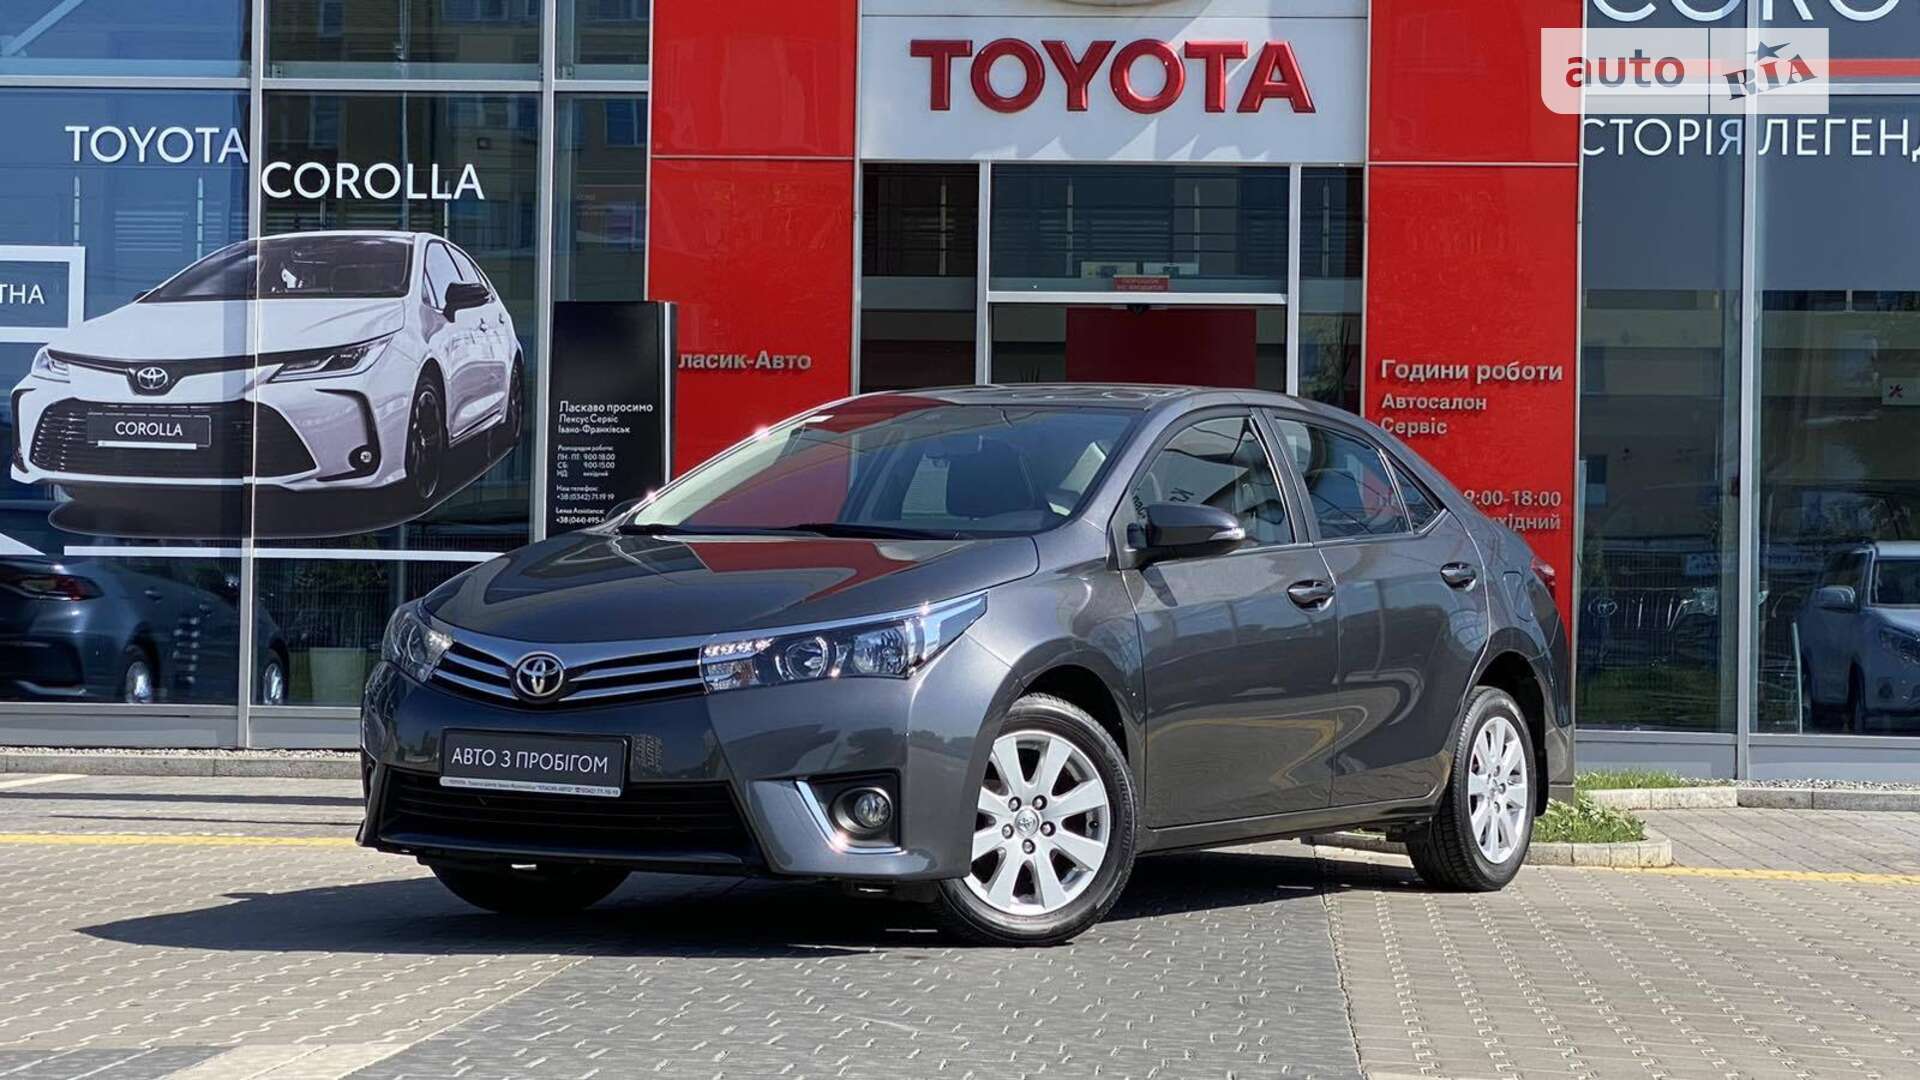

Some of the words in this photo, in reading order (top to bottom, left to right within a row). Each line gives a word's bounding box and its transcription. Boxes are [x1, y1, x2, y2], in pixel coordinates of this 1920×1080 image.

[910, 37, 1317, 114] TOYOTA
[65, 125, 249, 163] TOYOTA
[1583, 118, 1742, 156] СТОРІЯ
[1758, 118, 1920, 163] ЛЕГЕН
[261, 161, 485, 200] COROLLA
[1381, 359, 1469, 381] Години
[1477, 361, 1563, 385] роботи
[606, 403, 654, 414] просимо
[1381, 393, 1487, 410] Автосалон
[115, 421, 183, 437] COROLLA
[1380, 417, 1448, 437] Сервіс
[1464, 489, 1561, 507] 9:00-18:00
[1493, 514, 1561, 532] хідний
[451, 747, 497, 767] АВТО
[516, 751, 609, 775] ПРОБІГОМ
